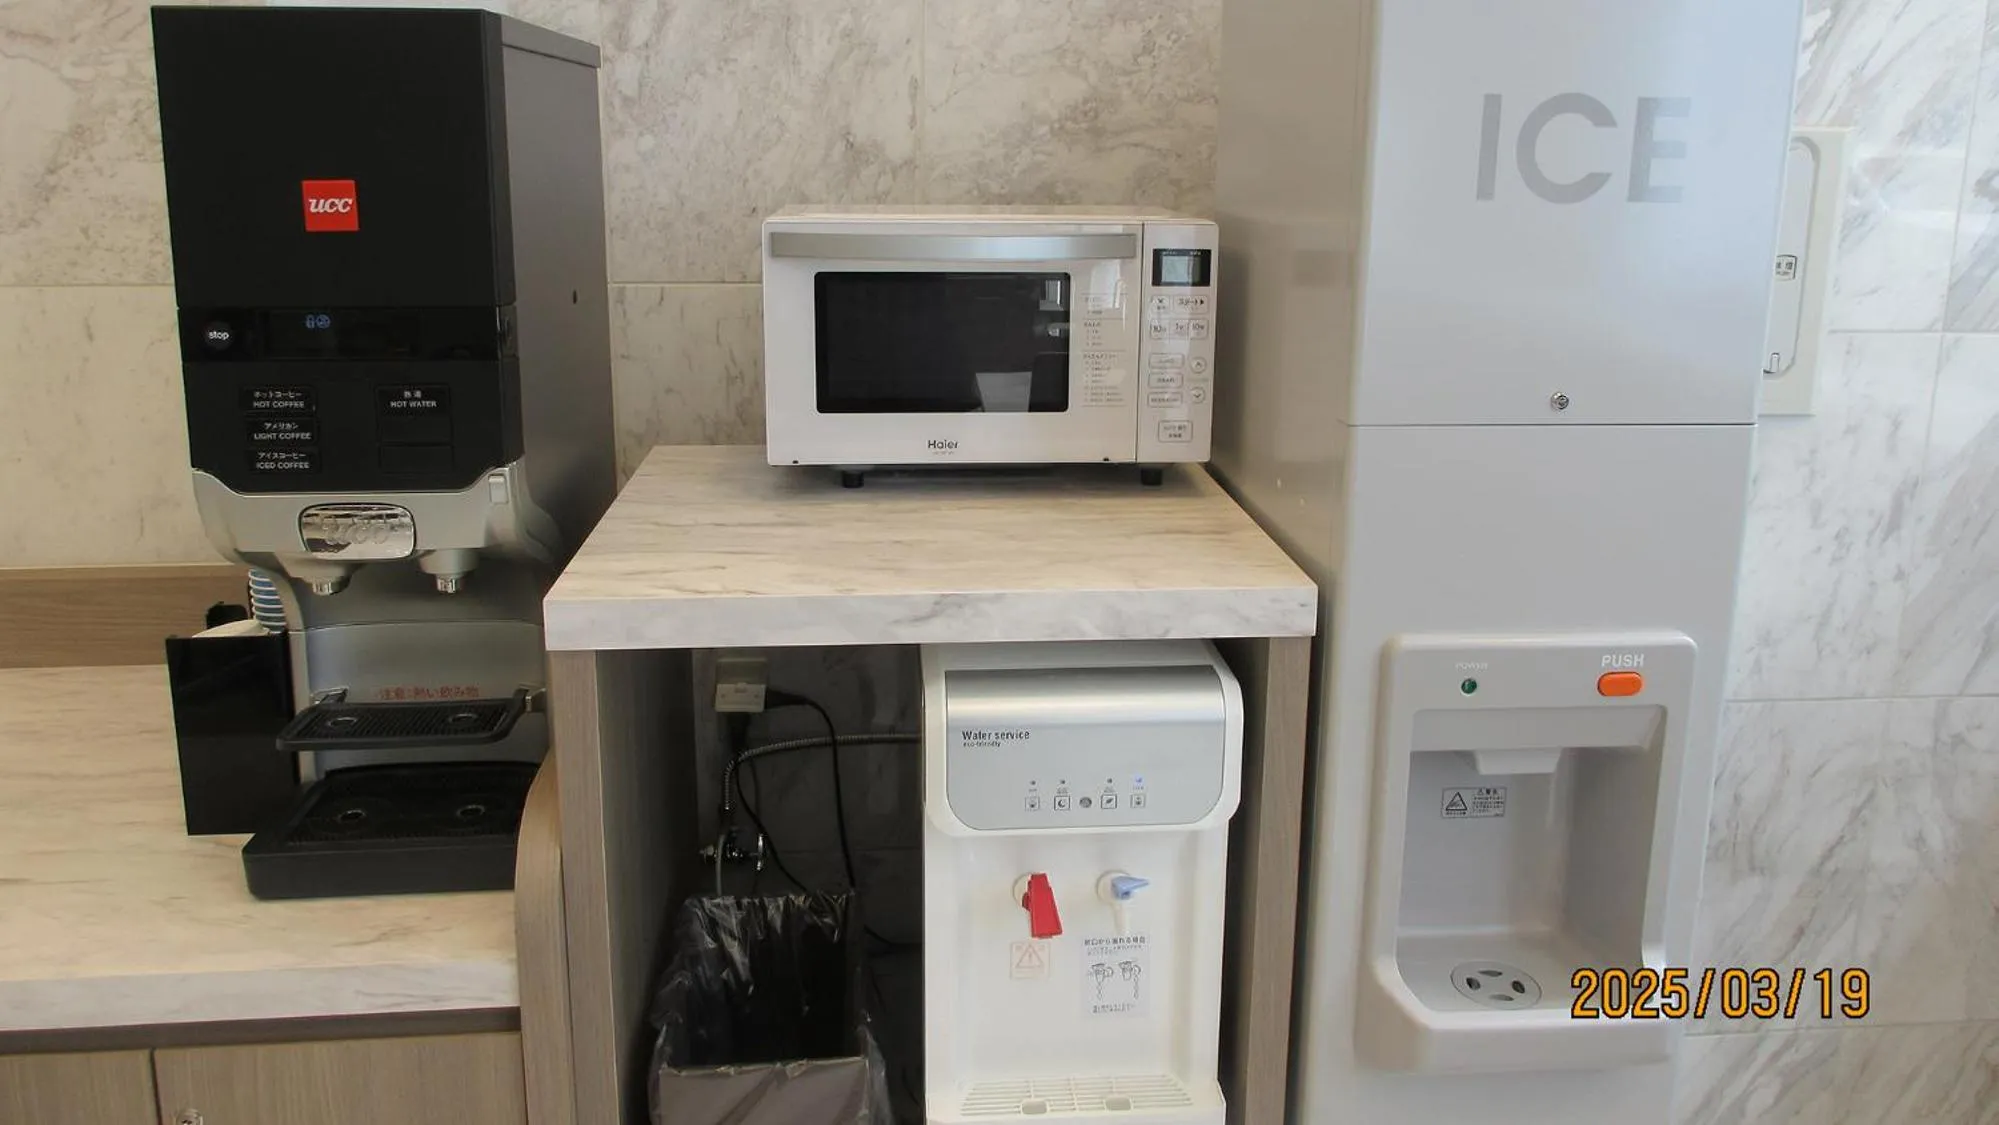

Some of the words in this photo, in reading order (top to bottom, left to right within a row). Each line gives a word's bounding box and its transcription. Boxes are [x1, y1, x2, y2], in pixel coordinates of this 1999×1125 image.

[1476, 92, 1691, 205] ICE
[208, 330, 230, 341] stop
[253, 390, 302, 398] ホットコーヒー
[390, 400, 408, 408] HOT
[409, 400, 437, 408] WATER
[264, 422, 299, 430] アメリカン
[278, 432, 312, 440] COFFEE
[927, 438, 959, 450] Haier
[255, 461, 276, 469] ICED
[277, 461, 310, 469] COFFEE
[1601, 653, 1645, 668] PUSH
[961, 729, 992, 741] Water
[994, 729, 1031, 741] service
